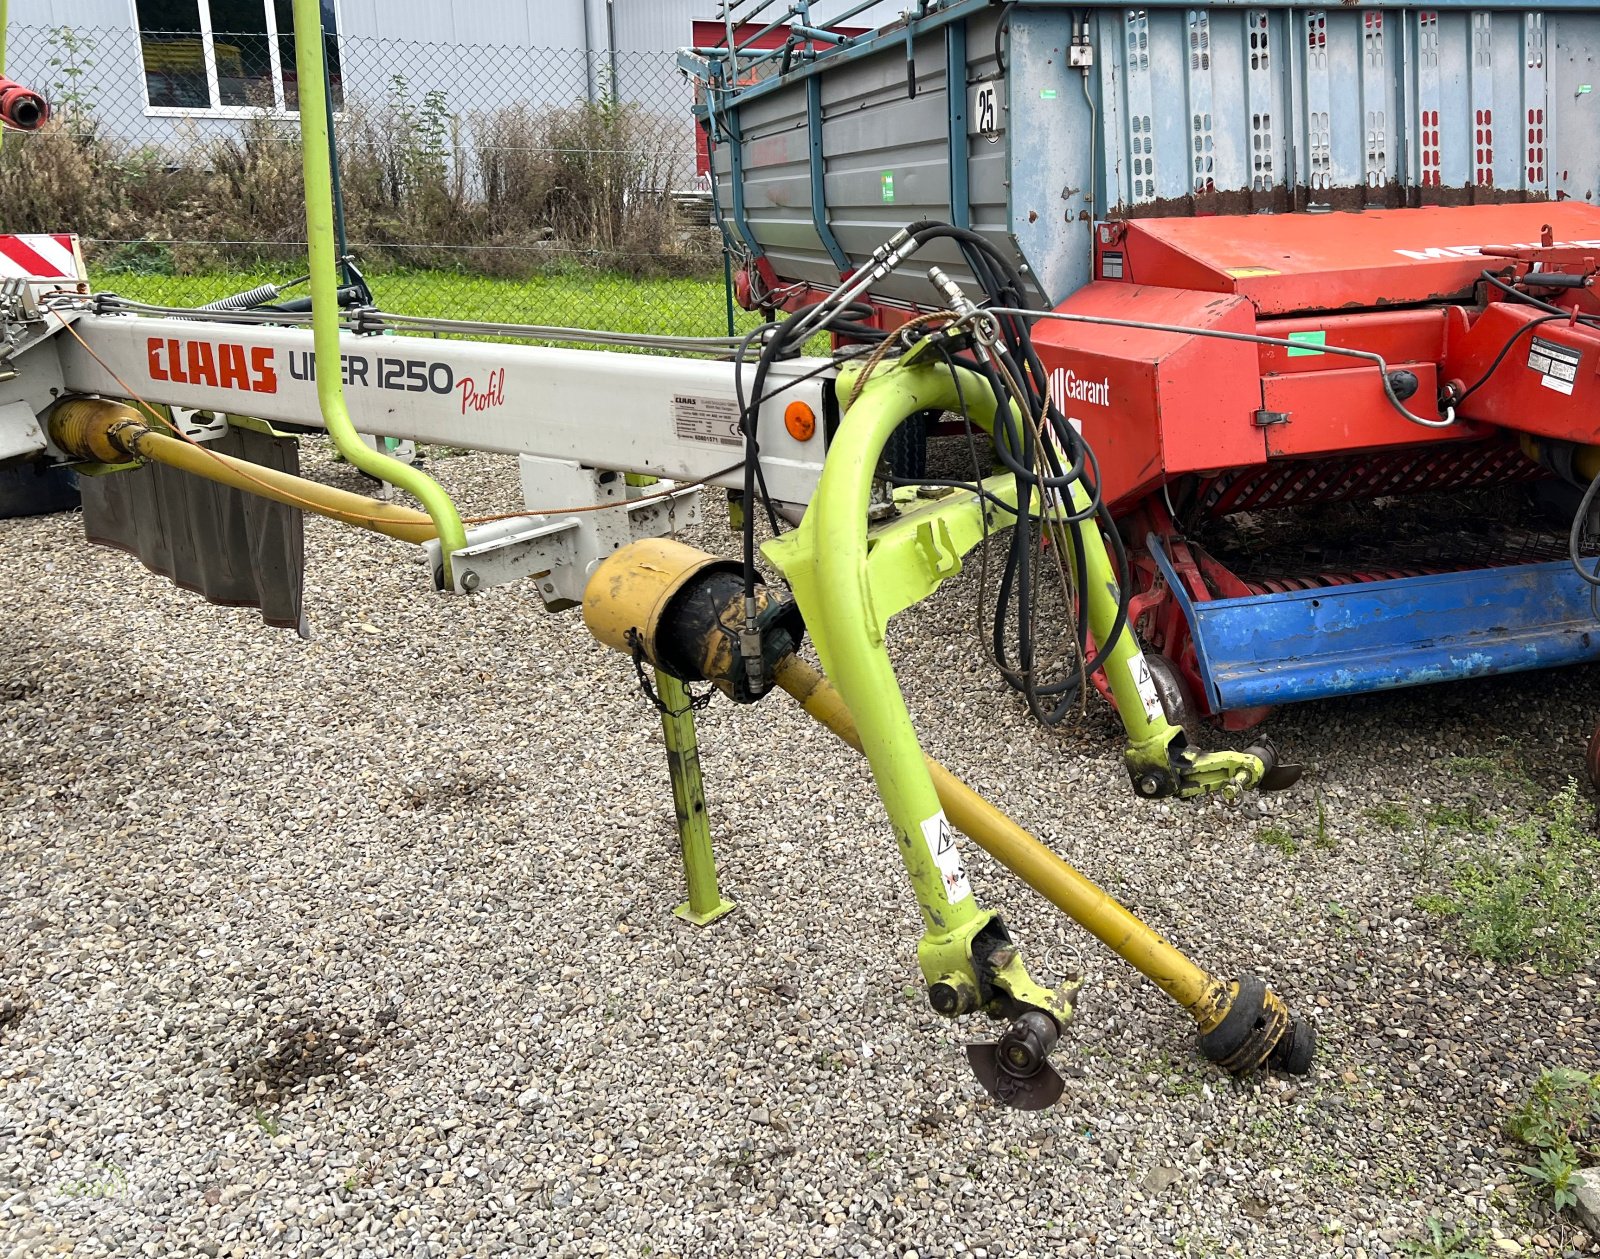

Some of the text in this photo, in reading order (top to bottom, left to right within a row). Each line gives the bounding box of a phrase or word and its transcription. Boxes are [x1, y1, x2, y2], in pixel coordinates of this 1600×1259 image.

[979, 89, 993, 133] 25
[147, 337, 277, 393] CLAAS
[377, 357, 454, 395] 1250
[455, 367, 505, 415] Profil
[1064, 369, 1110, 407] Garant
